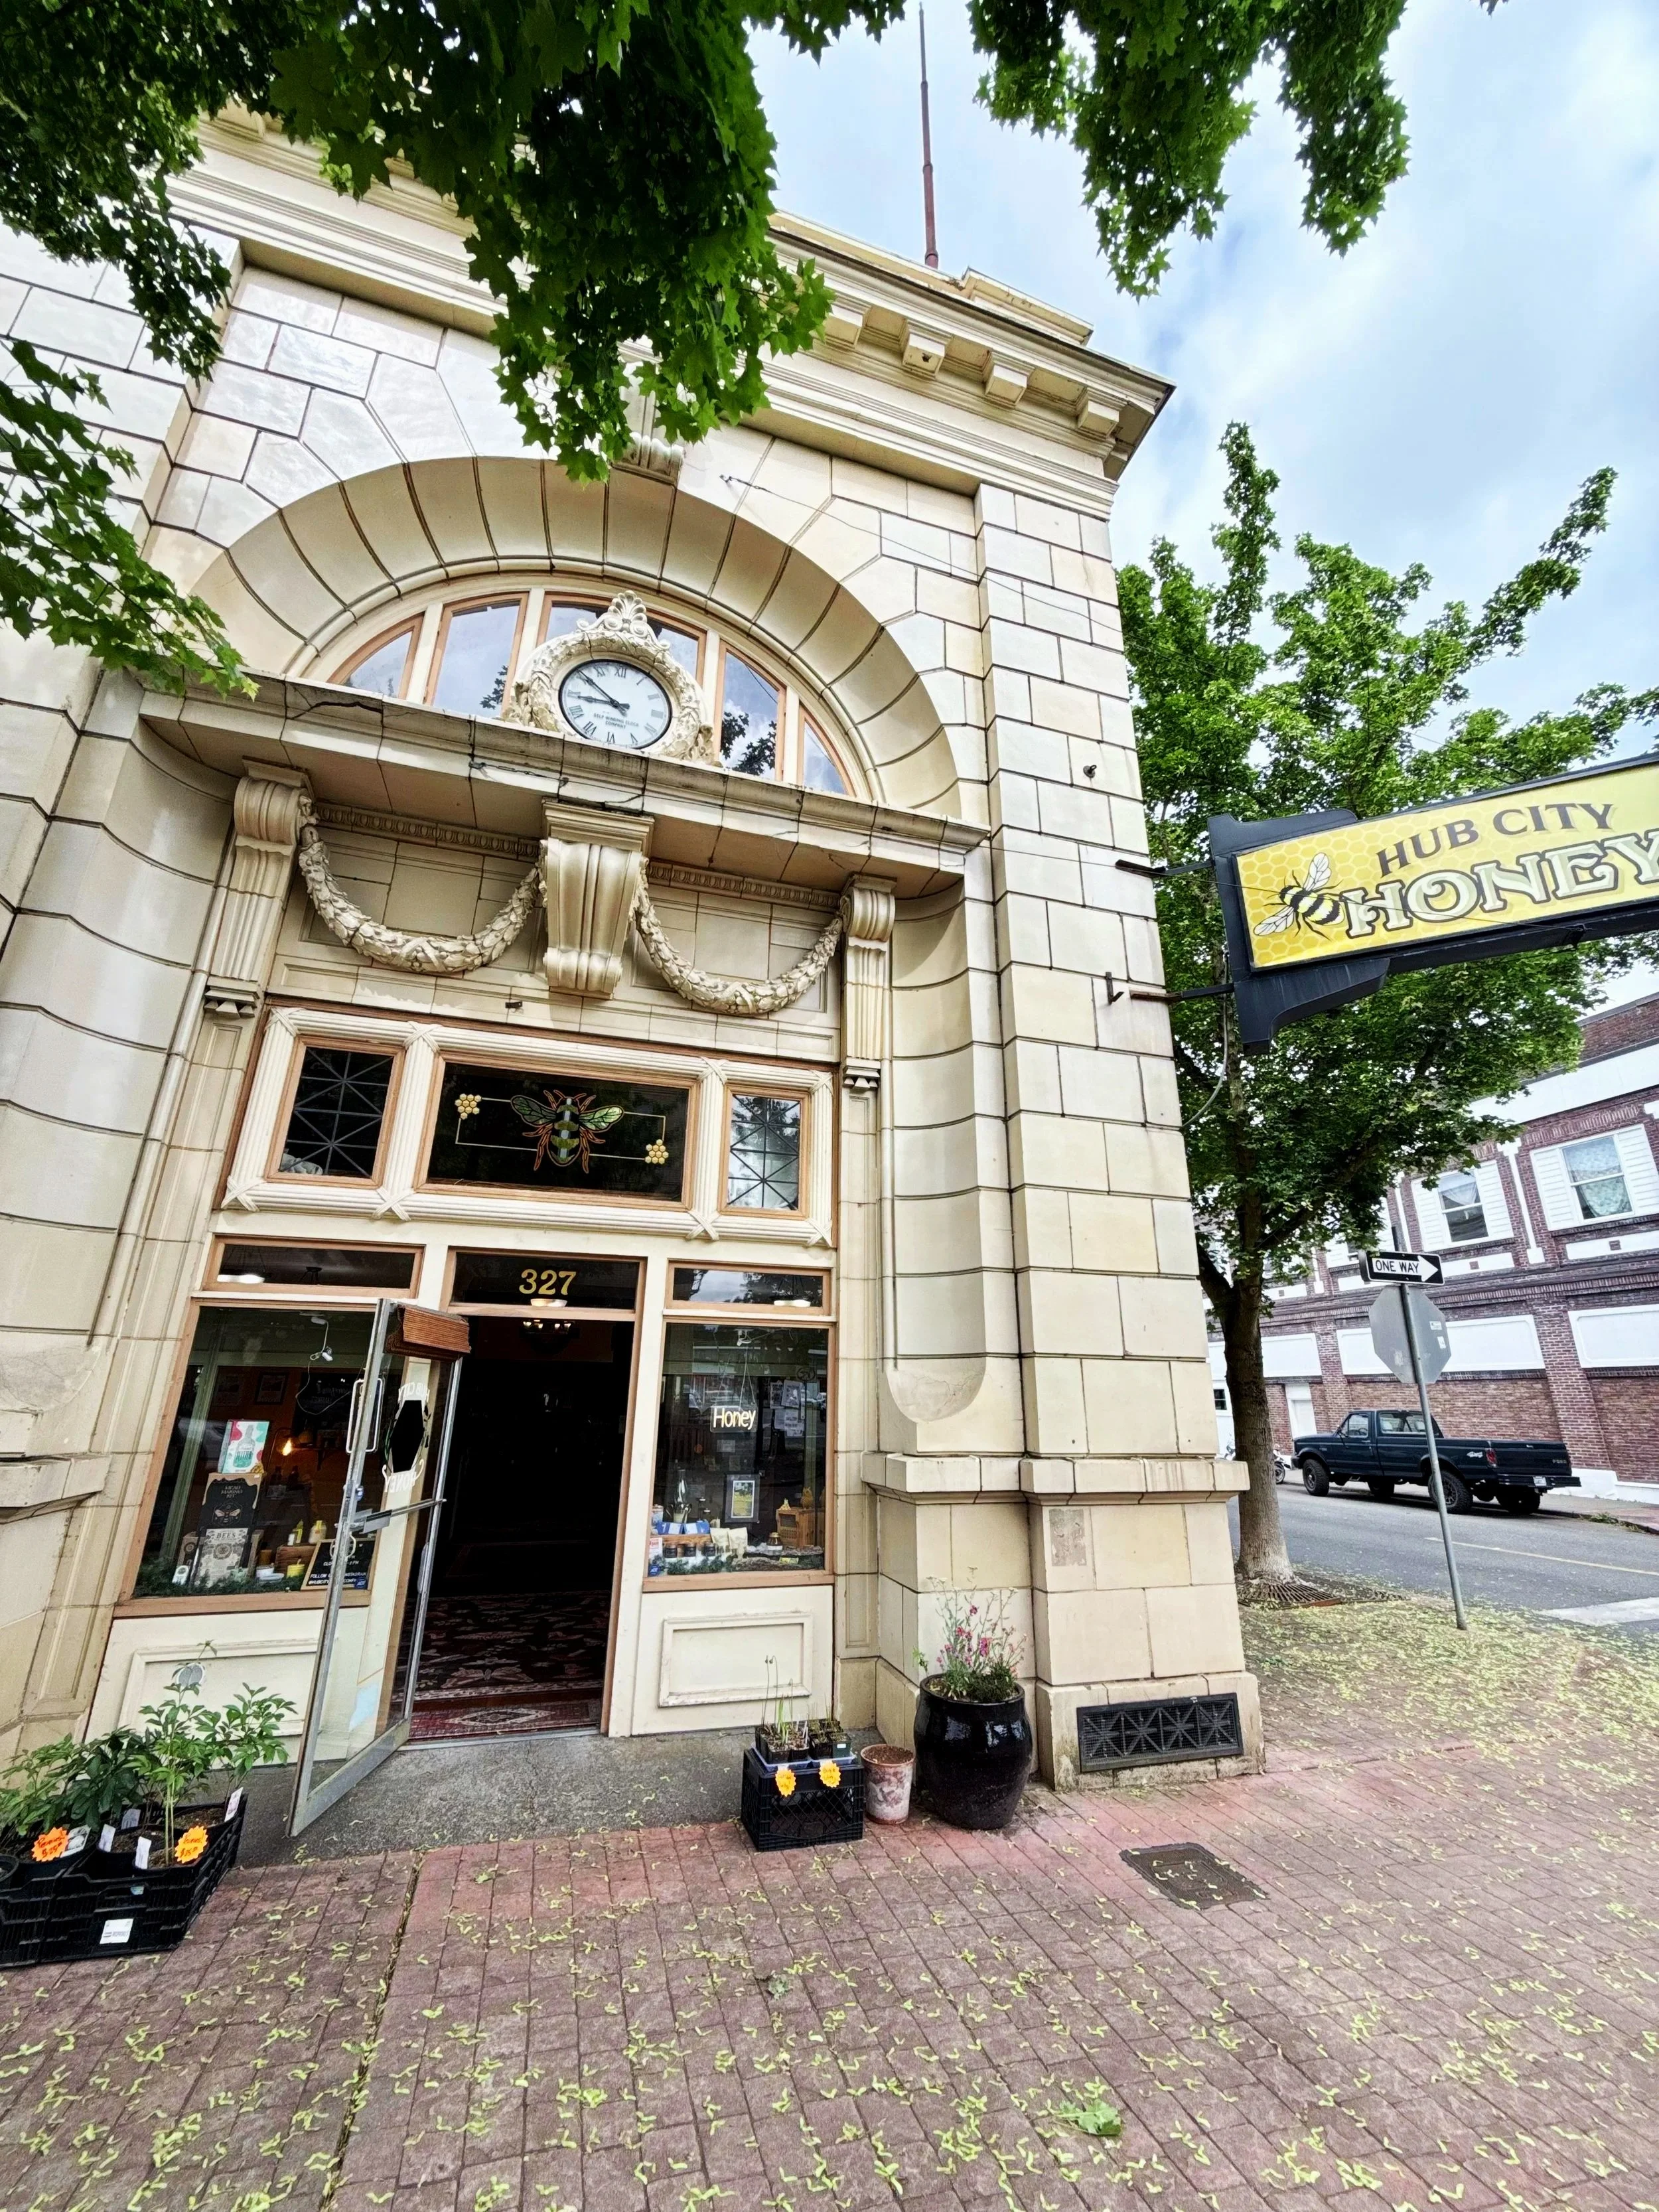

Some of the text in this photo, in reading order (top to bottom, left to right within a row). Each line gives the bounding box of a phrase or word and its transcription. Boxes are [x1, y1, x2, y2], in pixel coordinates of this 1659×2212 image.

[614, 666, 626, 678] XII
[1376, 802, 1613, 877] HUB CITY
[1344, 828, 1659, 939] HONEY
[1376, 1260, 1419, 1274] ONE WAY
[519, 1269, 577, 1295] 327
[713, 1407, 756, 1430] Honey
